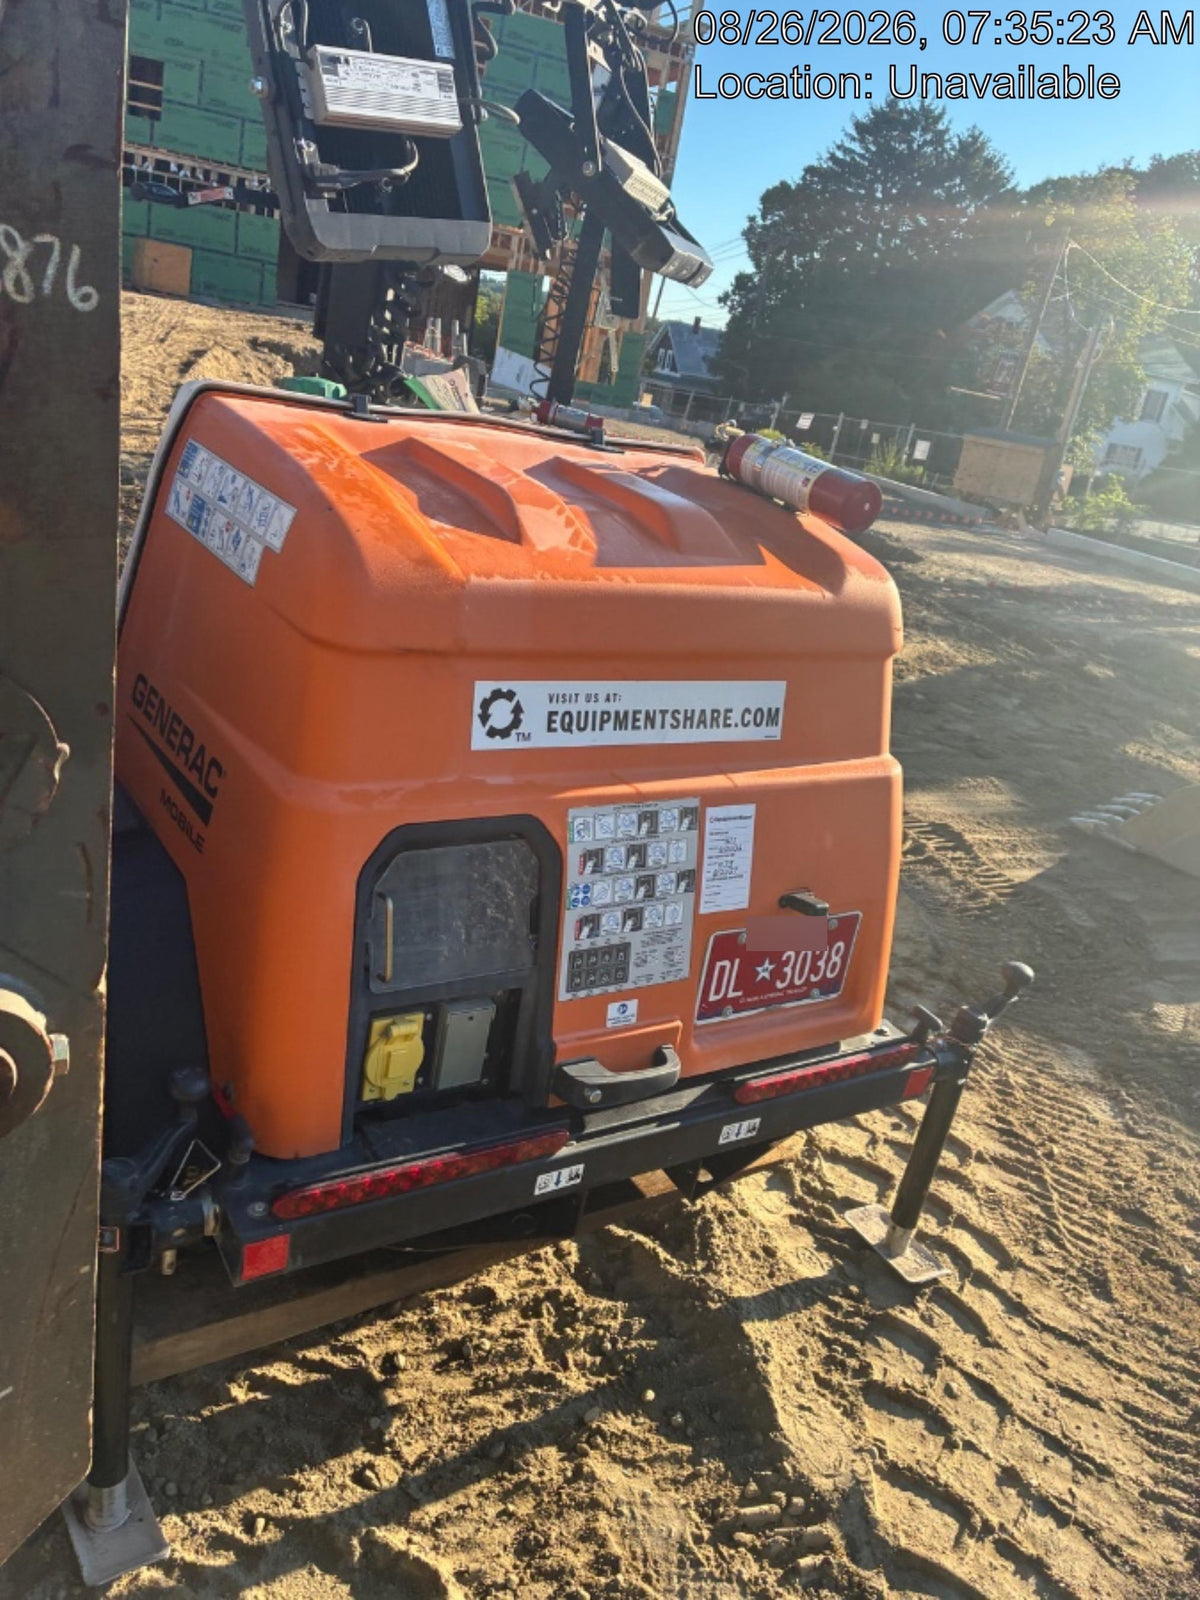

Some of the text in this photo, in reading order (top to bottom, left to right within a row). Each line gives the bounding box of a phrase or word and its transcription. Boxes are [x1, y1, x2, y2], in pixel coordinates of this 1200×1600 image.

[546, 706, 780, 734] EQUIPMENTSHARE.COM
[547, 692, 622, 704] VISIT US AT:
[132, 673, 223, 799] GENERAC
[515, 731, 532, 743] TM
[160, 788, 205, 854] MOBILE
[708, 957, 744, 1002] DL
[775, 941, 845, 990] 3038
